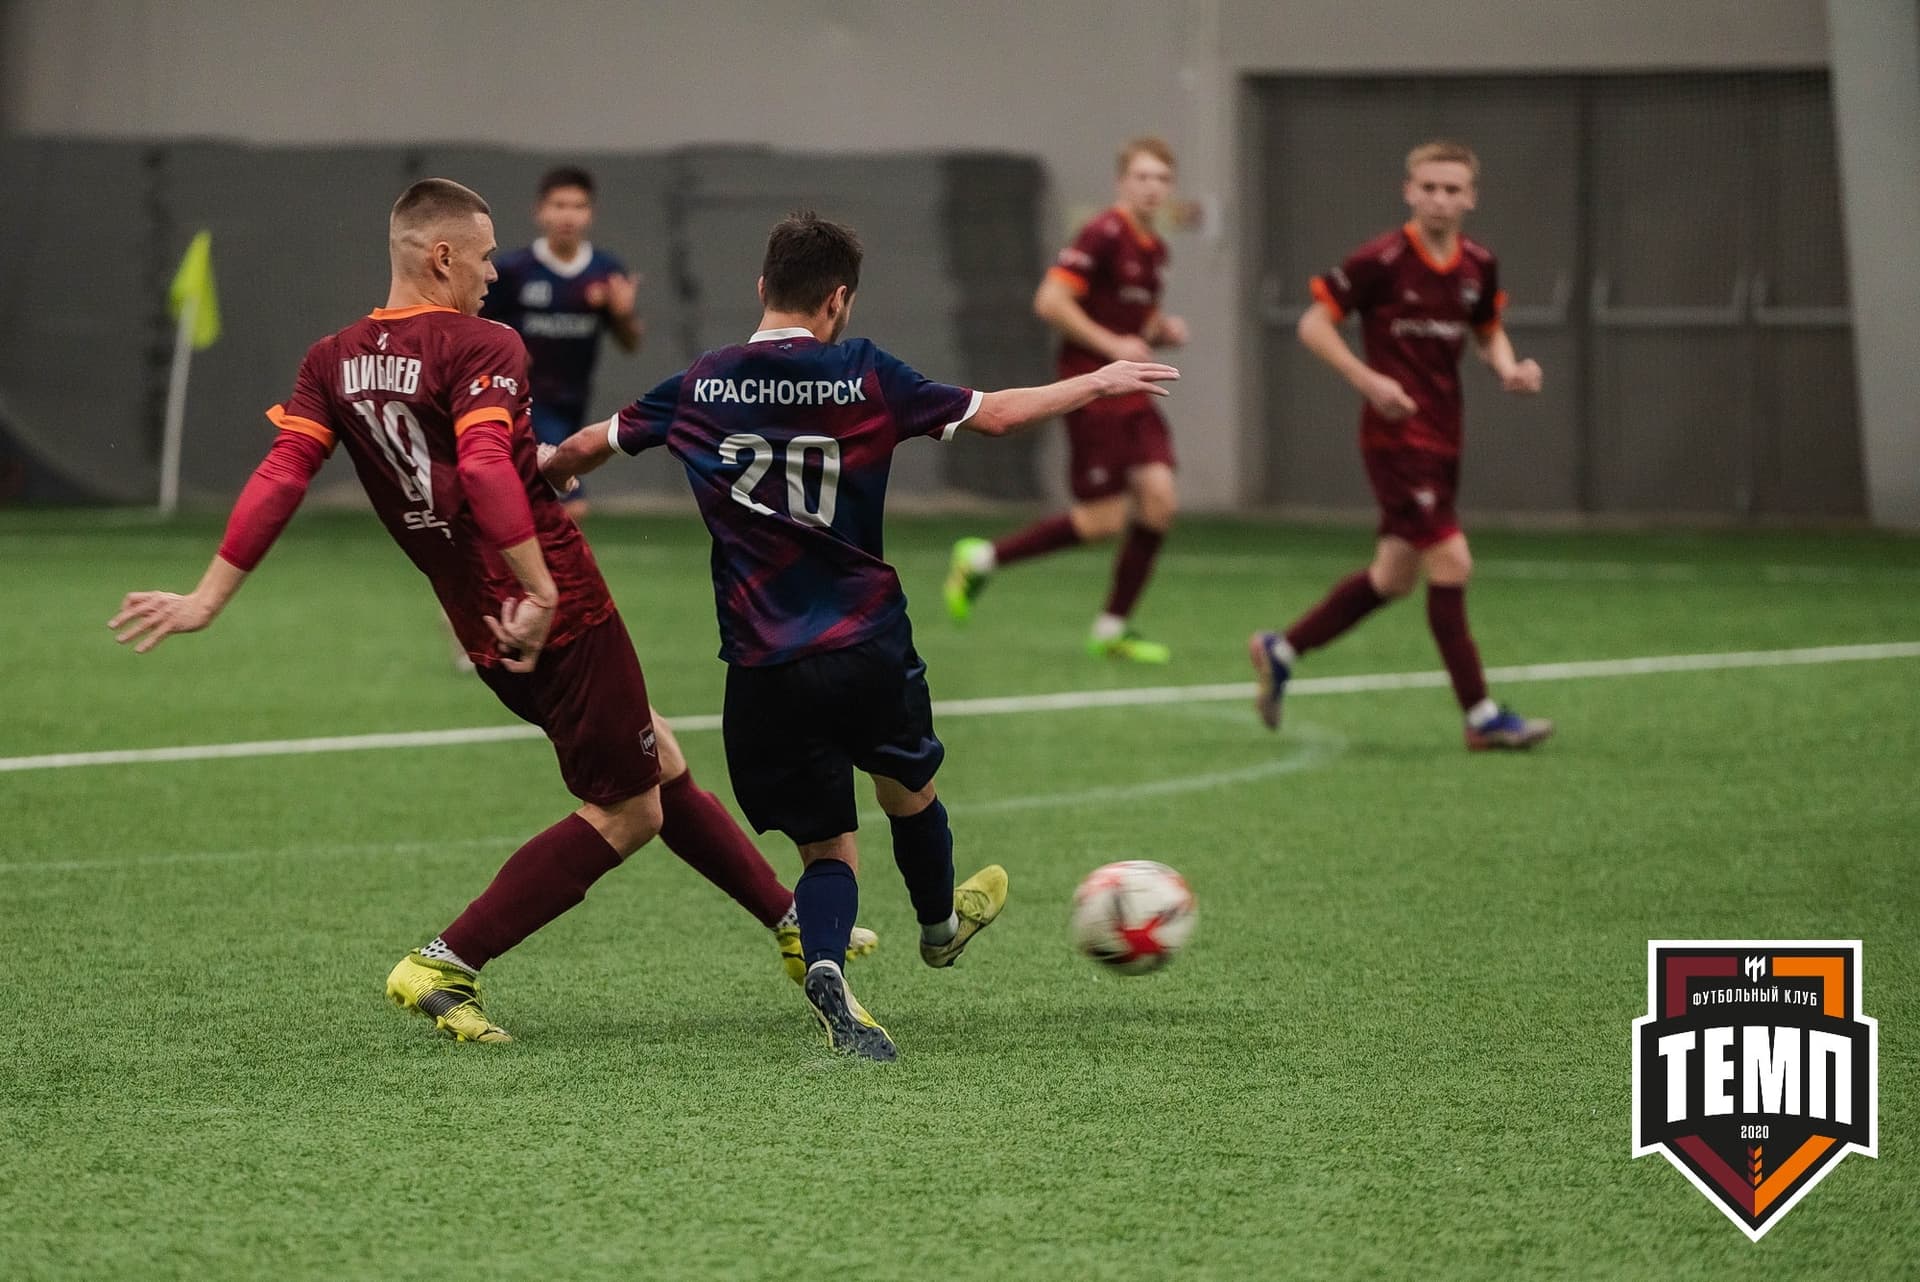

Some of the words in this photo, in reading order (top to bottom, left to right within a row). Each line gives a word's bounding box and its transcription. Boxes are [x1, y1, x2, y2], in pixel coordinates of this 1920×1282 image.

[343, 355, 422, 394] ШИБАЕВ
[694, 377, 867, 405] КРАСНОЯРСК
[352, 400, 434, 510] 19
[718, 433, 841, 528] 20
